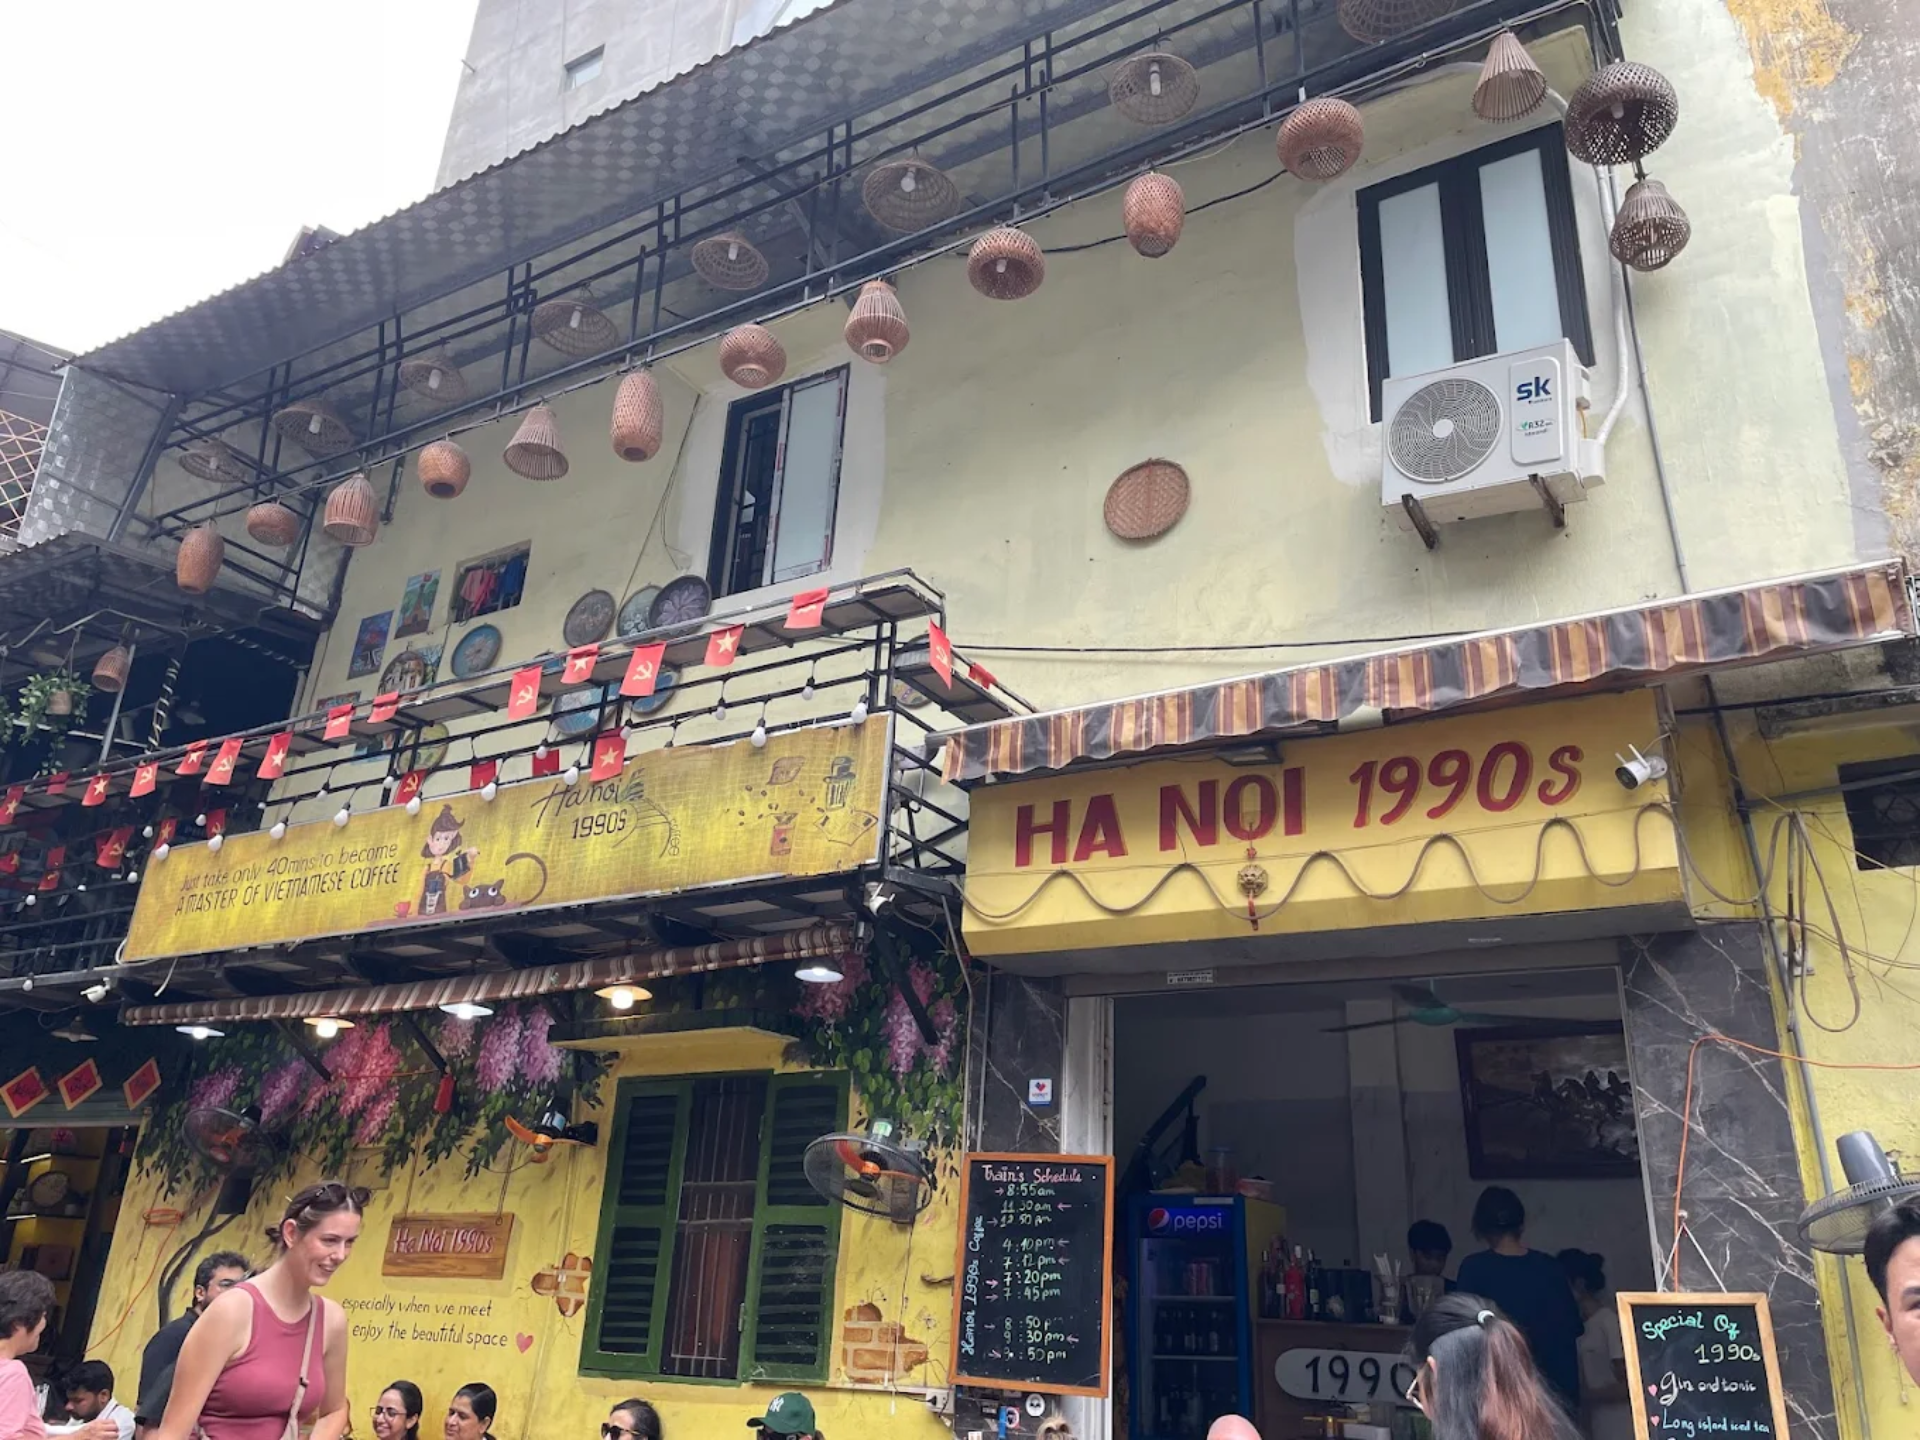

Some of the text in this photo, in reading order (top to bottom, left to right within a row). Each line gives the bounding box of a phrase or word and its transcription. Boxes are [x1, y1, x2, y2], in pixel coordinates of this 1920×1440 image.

[530, 777, 623, 828] Hanoi
[1015, 740, 1584, 867] HA NOI 1990s
[202, 869, 229, 888] take
[232, 863, 262, 885] only
[338, 843, 398, 865] become
[175, 895, 184, 916] A
[242, 883, 262, 906] OF
[264, 870, 345, 902] VIETNAMESE
[350, 862, 401, 889] COFFEE
[1033, 1166, 1083, 1183] Schedule
[1174, 1212, 1222, 1233] pepsi
[964, 1259, 980, 1306] 1990s
[342, 1293, 493, 1317] especially when we meet
[352, 1320, 509, 1350] enjoy the beautiful space
[961, 1310, 976, 1355] Hanoi
[1642, 1310, 1704, 1341] Special
[1694, 1344, 1761, 1364] 1990s
[1721, 1379, 1756, 1392] tonic
[1662, 1408, 1770, 1437] Long island iced tea
